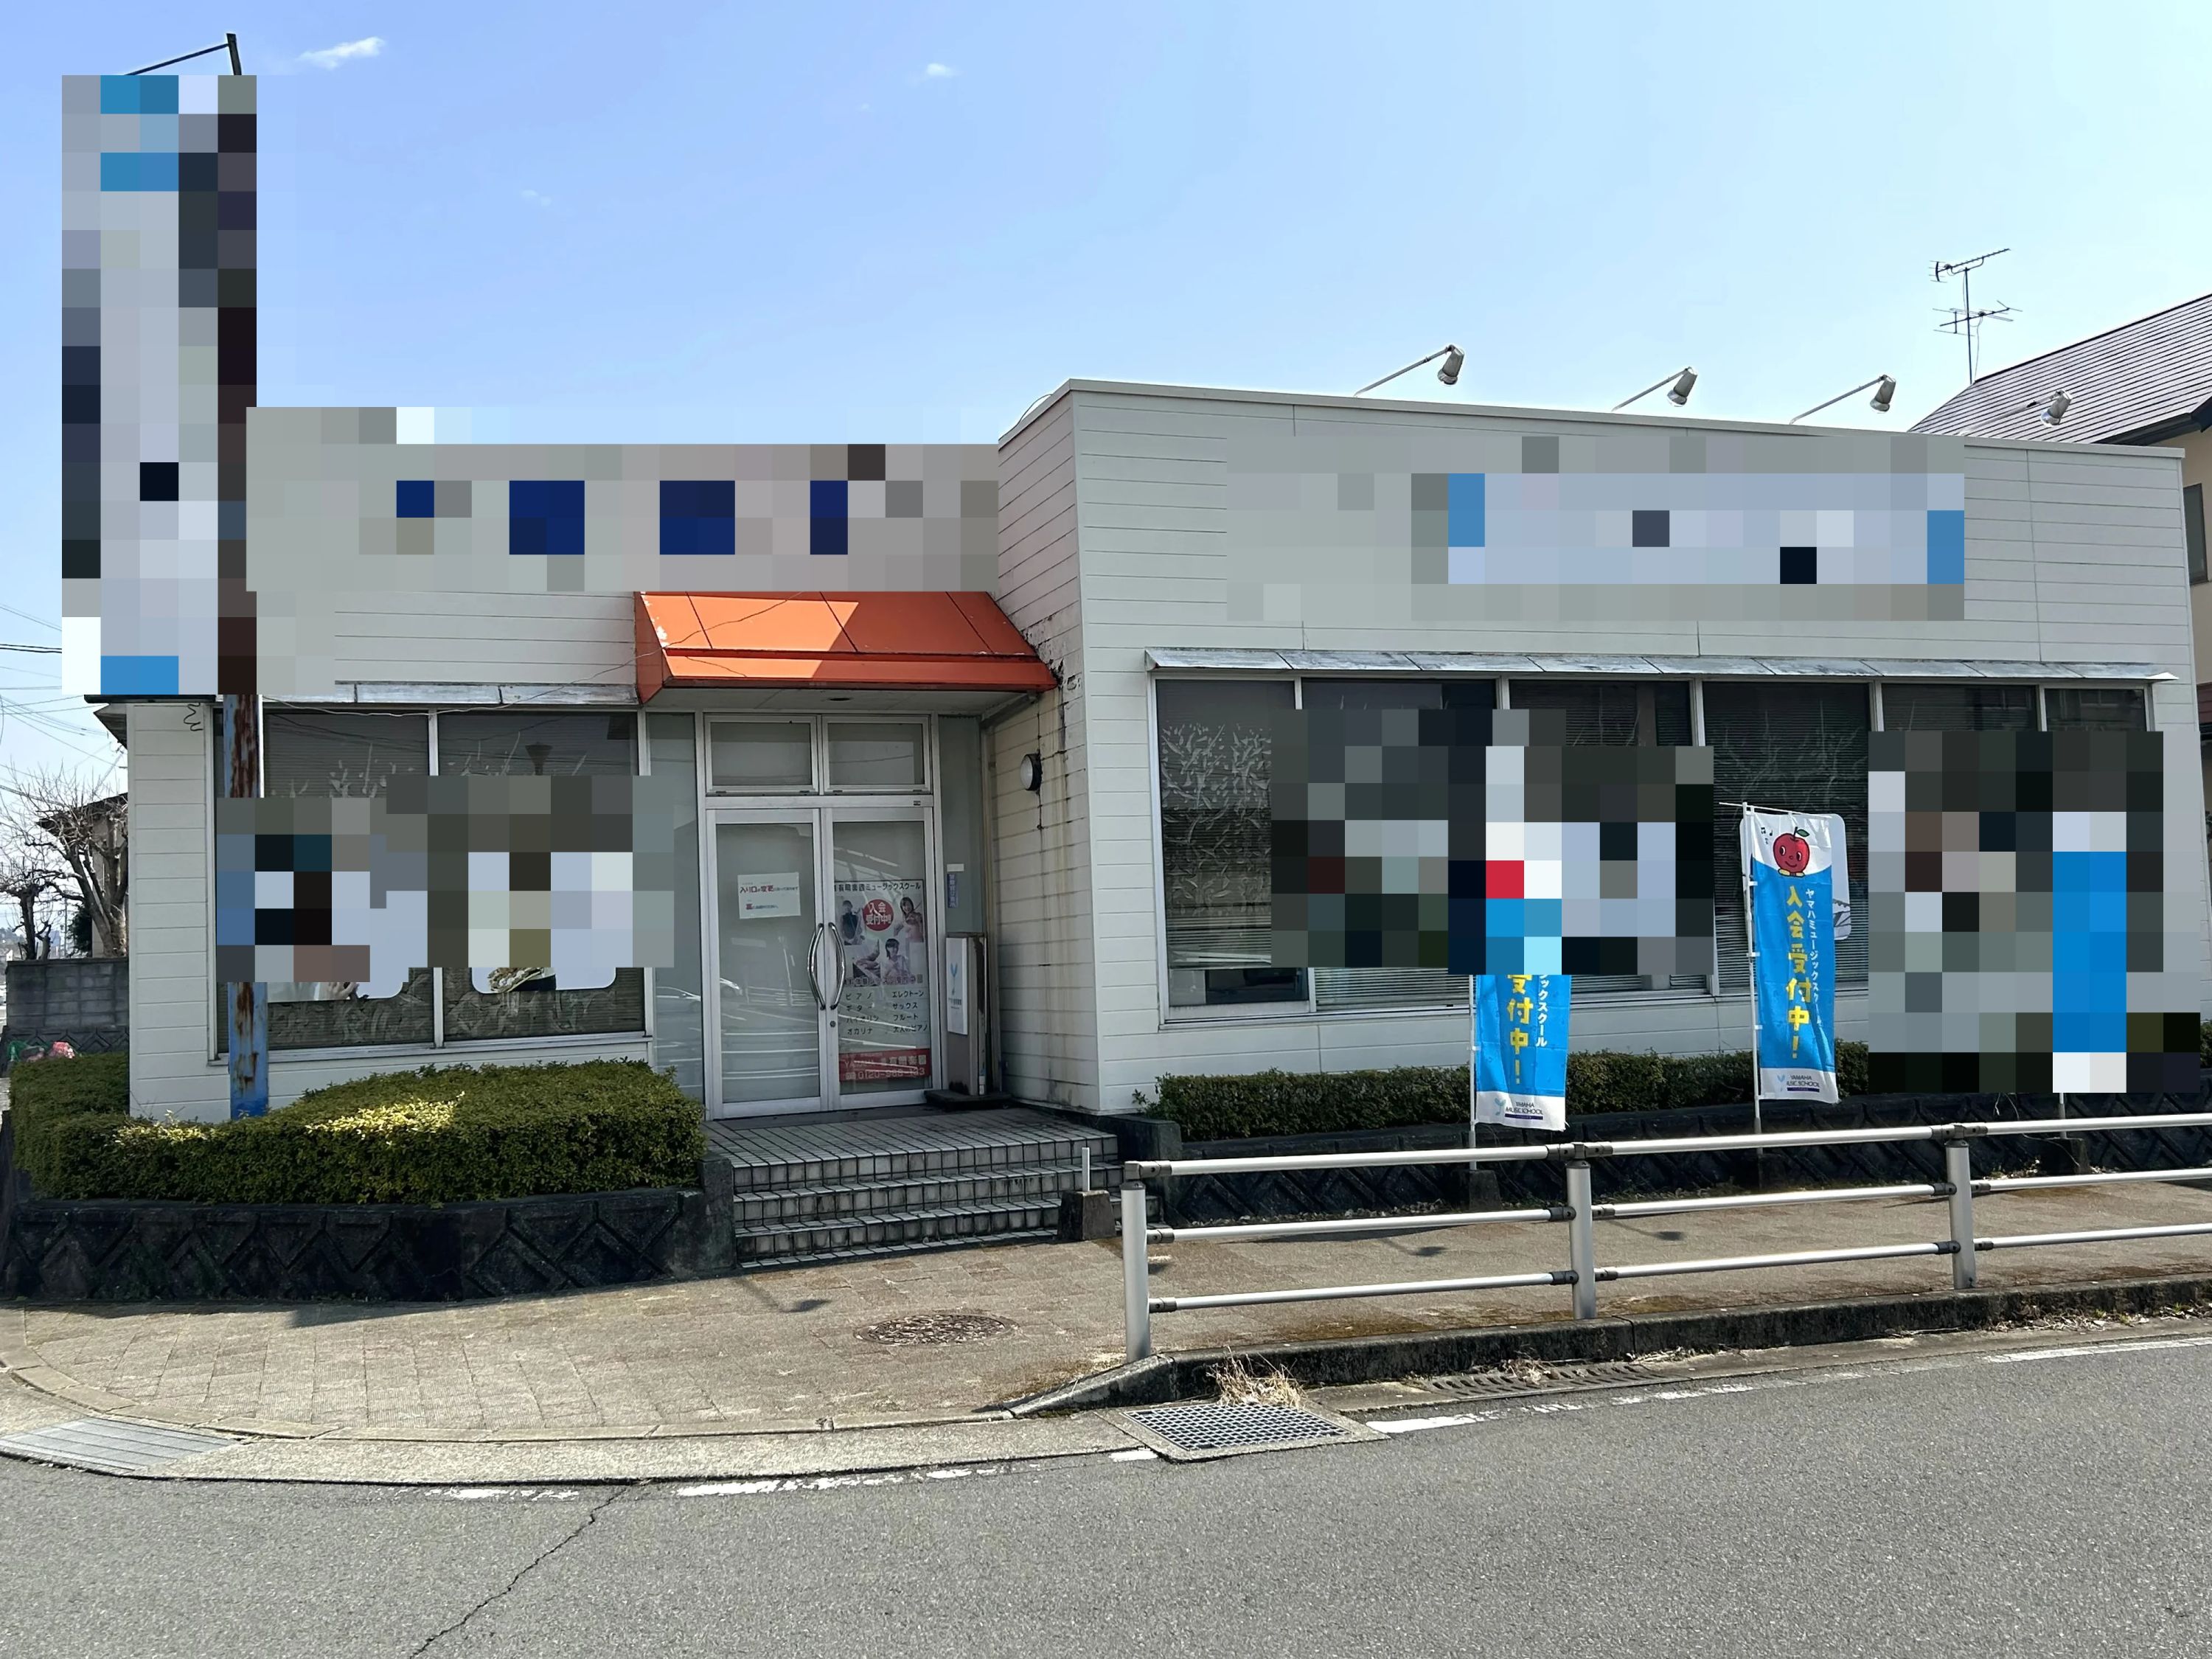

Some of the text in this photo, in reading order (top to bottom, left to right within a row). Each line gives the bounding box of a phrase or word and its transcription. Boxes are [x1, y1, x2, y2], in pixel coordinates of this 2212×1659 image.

[1806, 888, 1823, 1027] ヤマハミュージックスクール
[1786, 885, 1812, 1060] 入会受付中!
[846, 992, 873, 1001] ピアノ
[891, 990, 925, 998] エレクトーン
[892, 1002, 918, 1011] サックス
[893, 1013, 919, 1021] フルート
[847, 1028, 873, 1036] オカリナ
